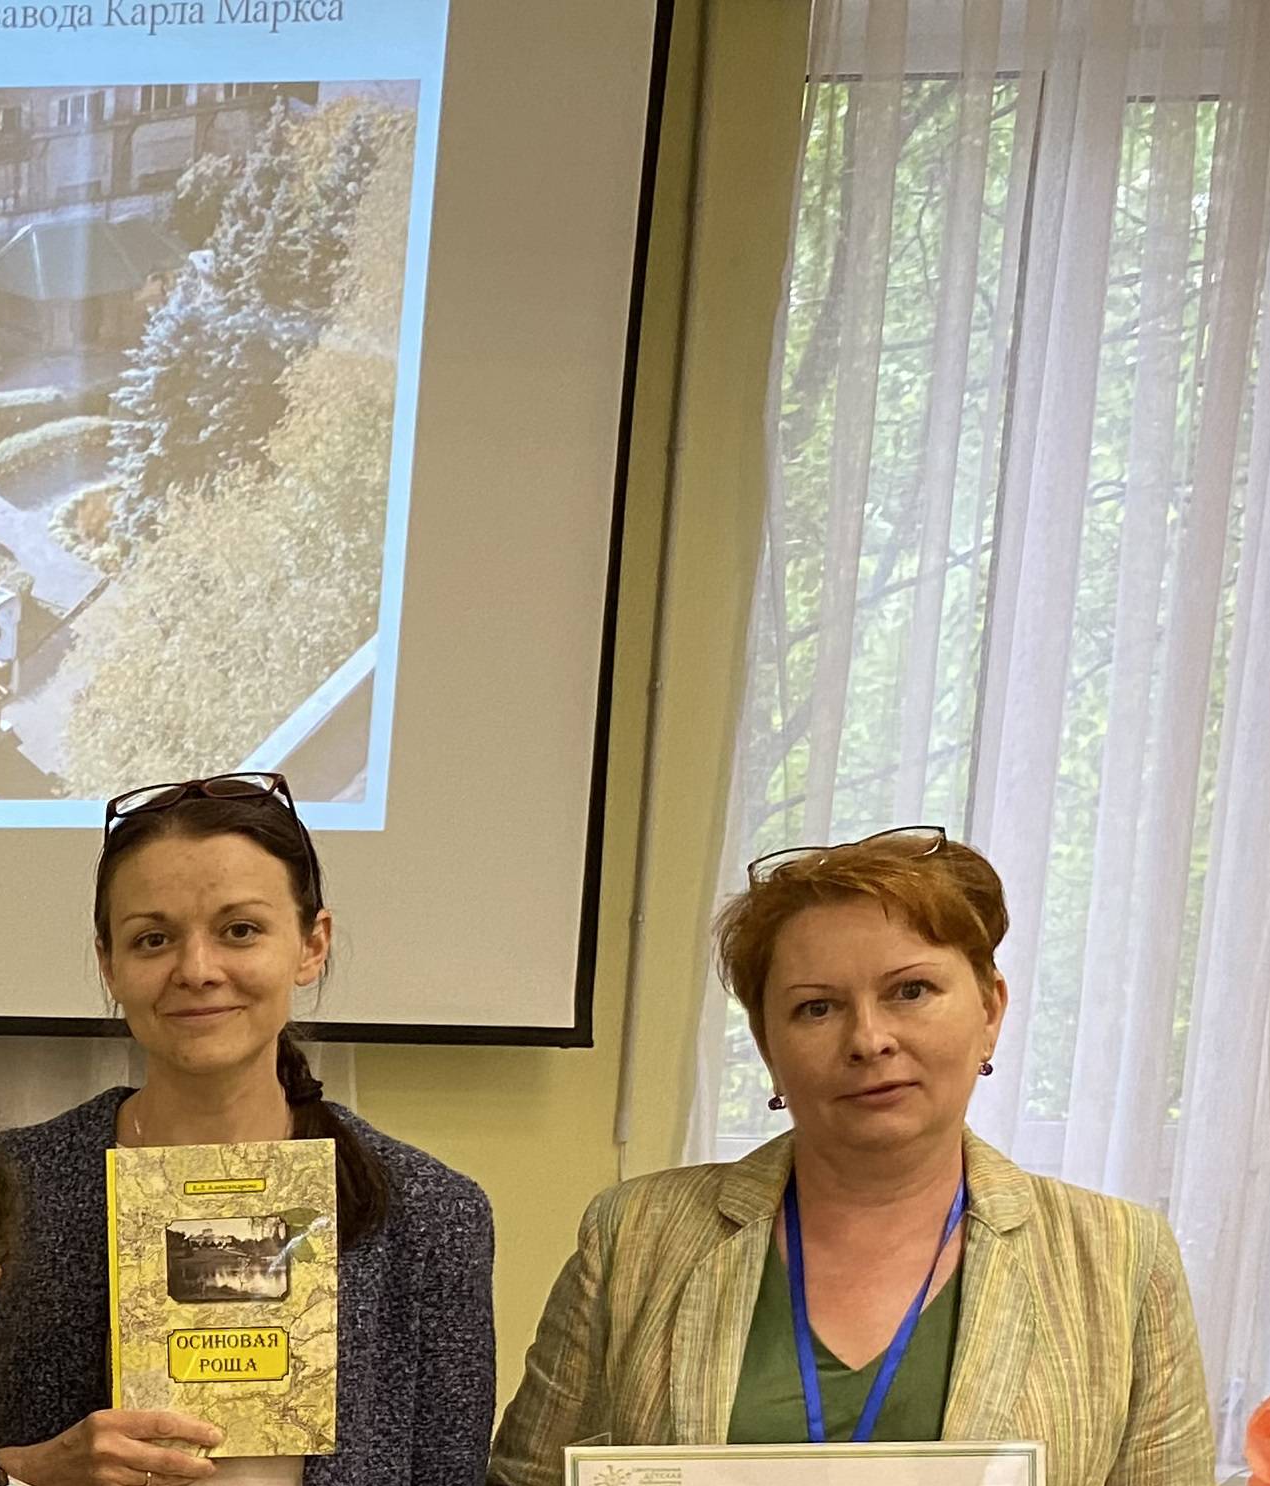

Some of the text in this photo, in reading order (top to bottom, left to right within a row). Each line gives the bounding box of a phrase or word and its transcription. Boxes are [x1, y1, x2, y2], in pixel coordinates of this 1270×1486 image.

[102, 0, 206, 36] Карла
[214, 0, 344, 34] Маркса
[175, 1332, 279, 1350] ОСИНОВАЯ
[199, 1357, 258, 1373] РОЩА
